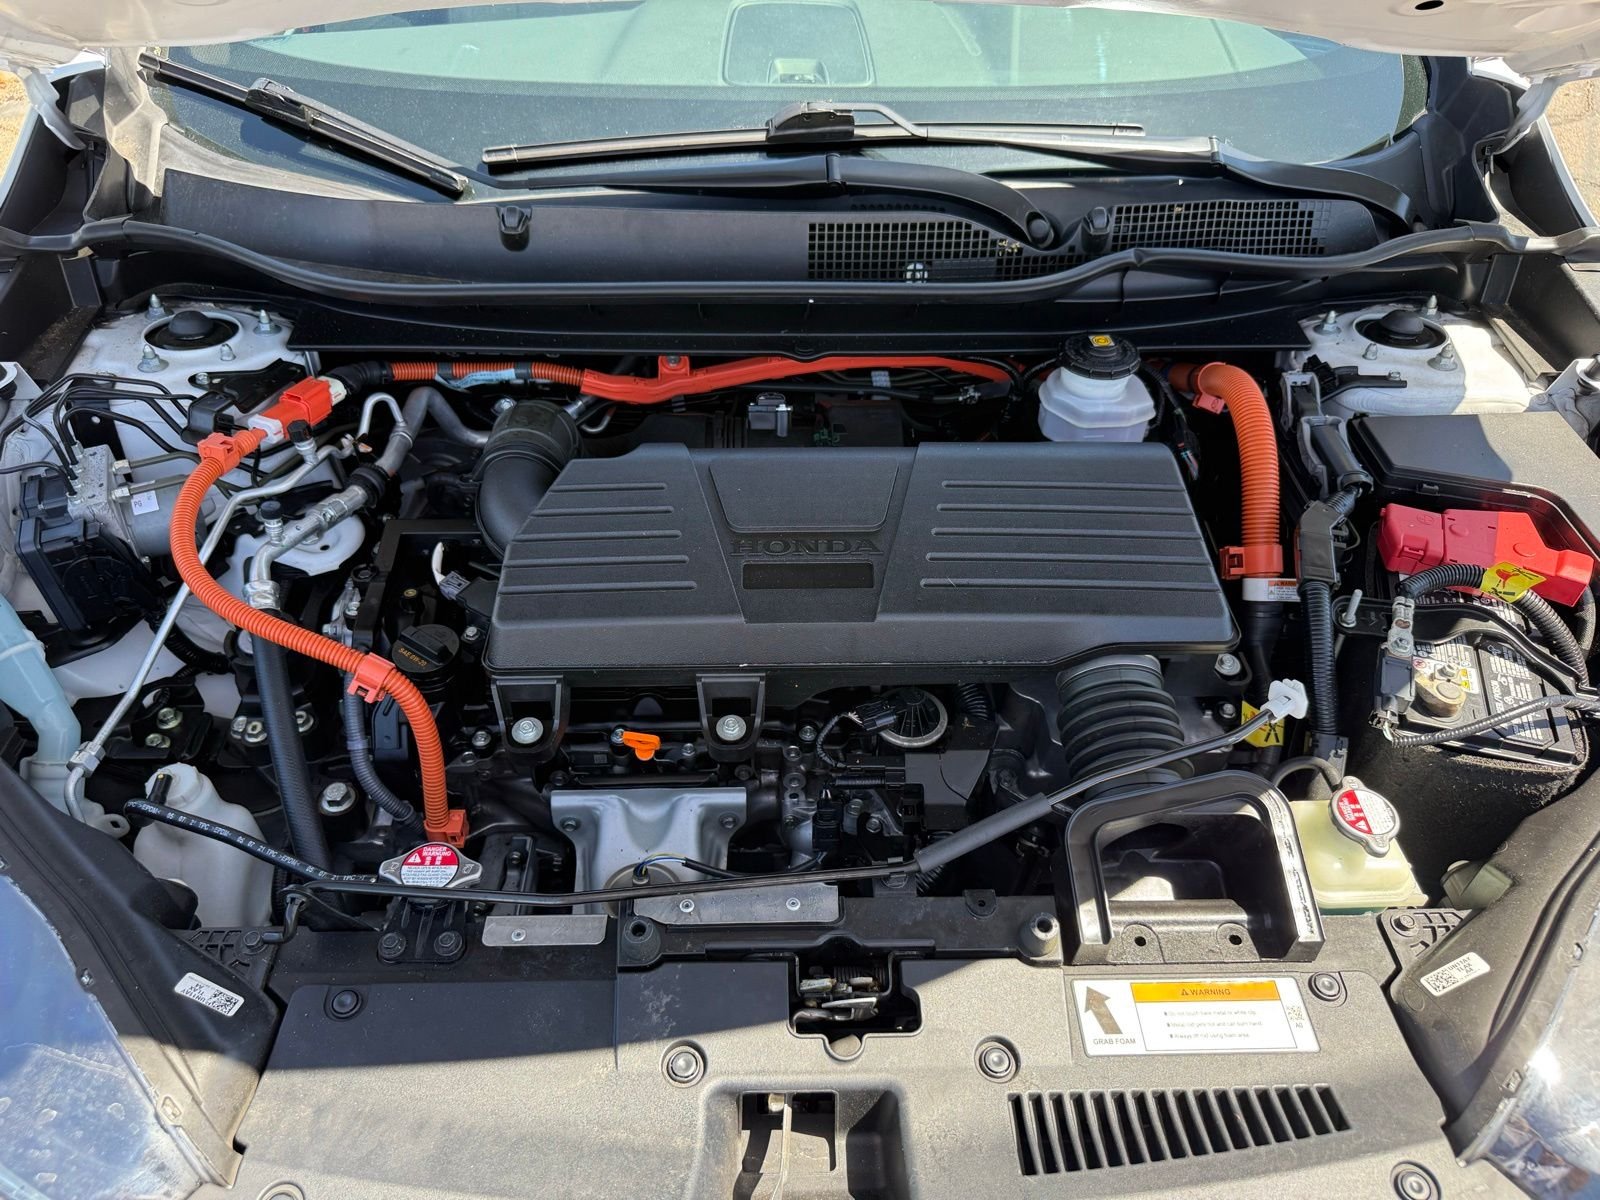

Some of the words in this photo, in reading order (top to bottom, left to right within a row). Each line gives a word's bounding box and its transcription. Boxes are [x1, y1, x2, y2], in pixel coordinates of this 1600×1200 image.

[133, 500, 143, 509] PG
[730, 539, 884, 557] HONDA
[1190, 988, 1231, 996] WARNING
